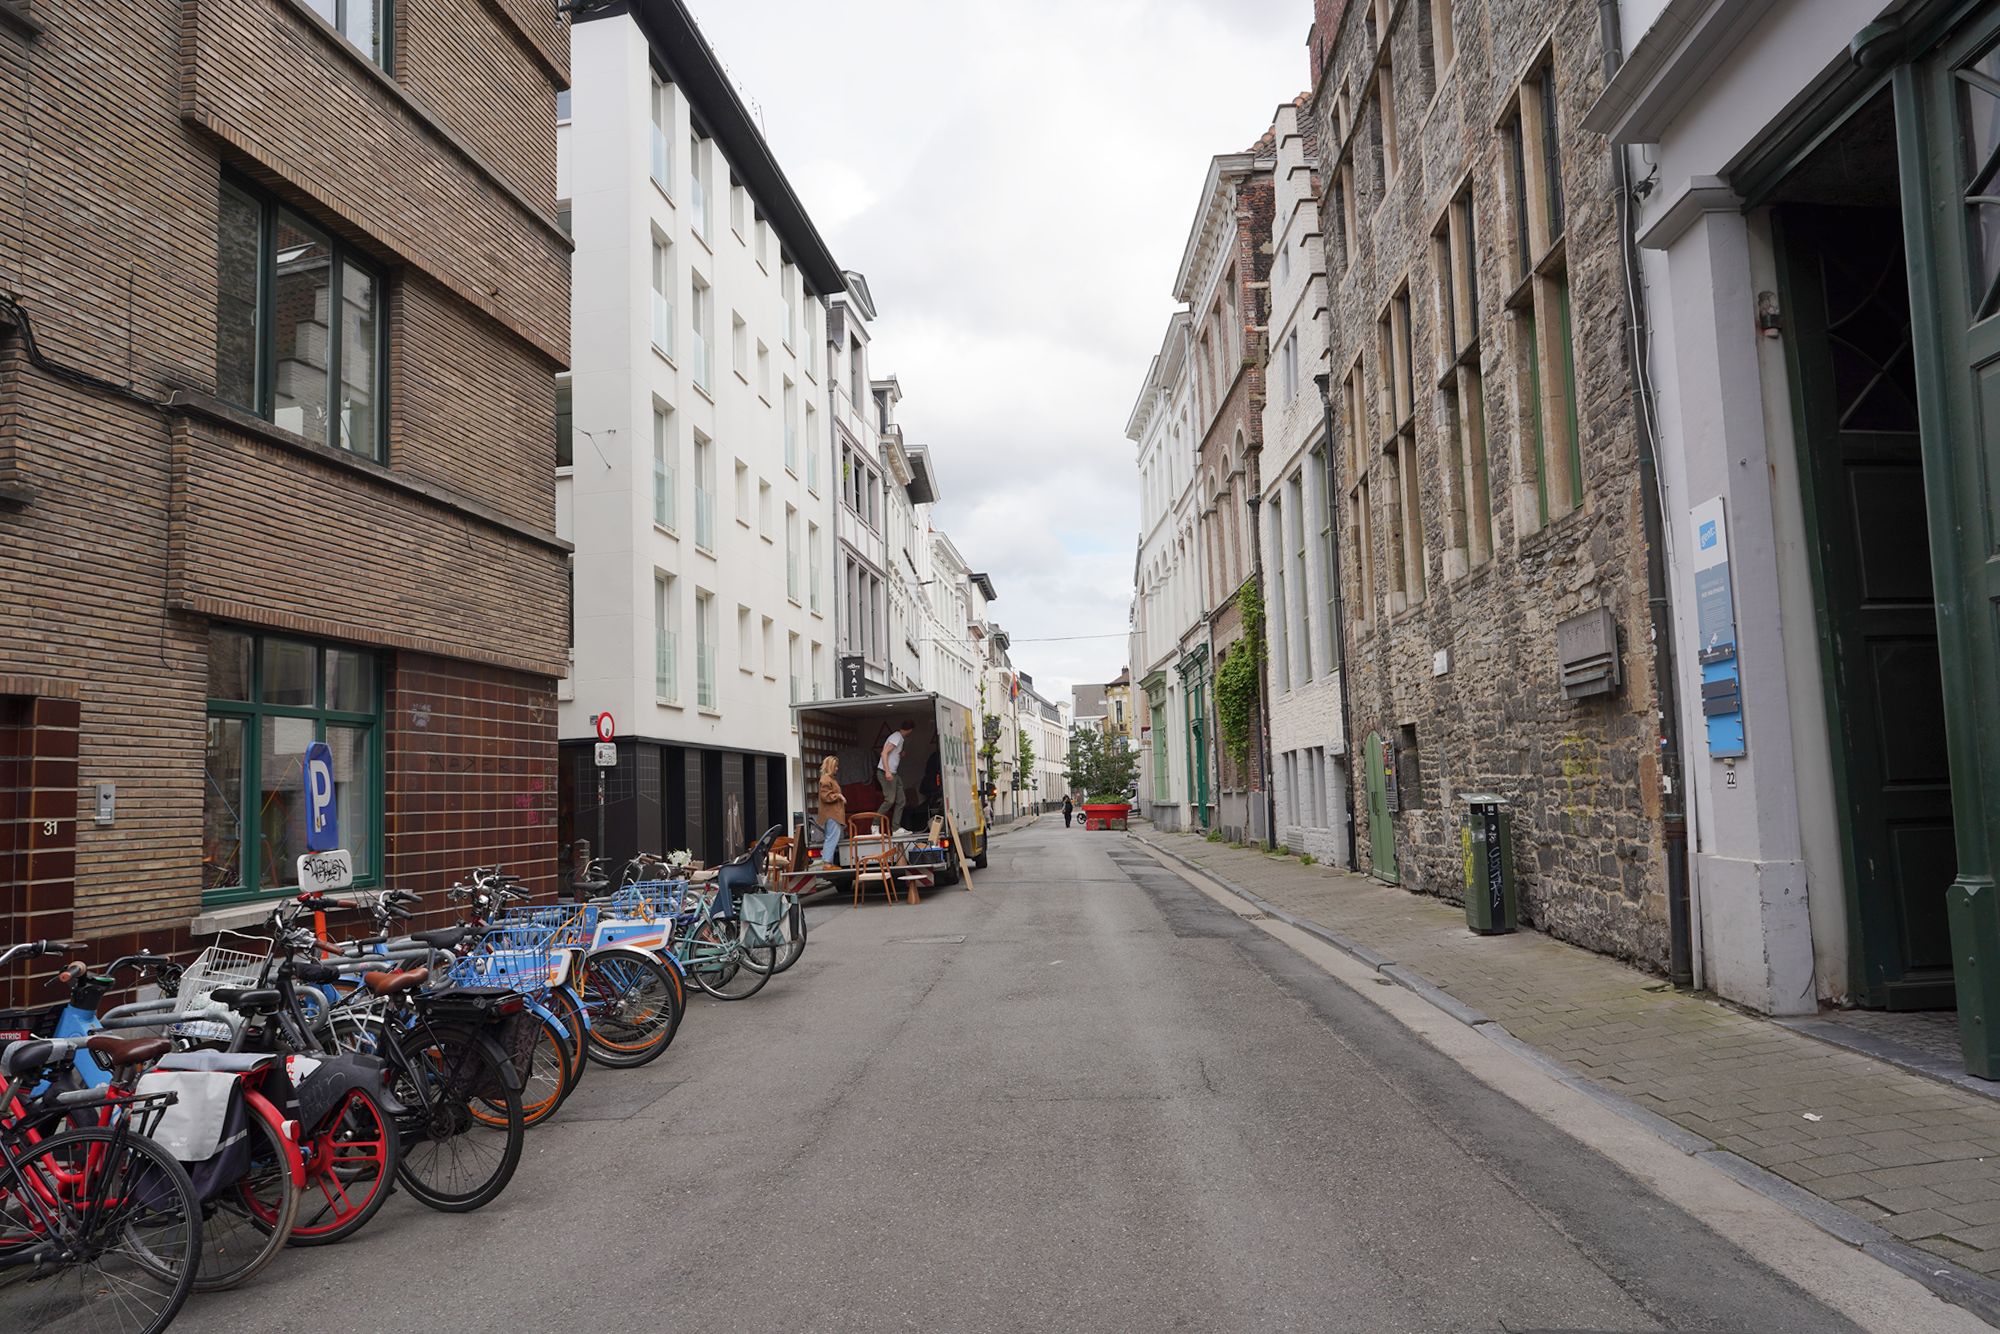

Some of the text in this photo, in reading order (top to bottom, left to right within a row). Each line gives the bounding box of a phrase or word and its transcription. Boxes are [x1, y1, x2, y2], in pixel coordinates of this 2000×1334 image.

[1726, 772, 1736, 785] 22
[309, 759, 332, 833] P
[43, 821, 58, 836] 31
